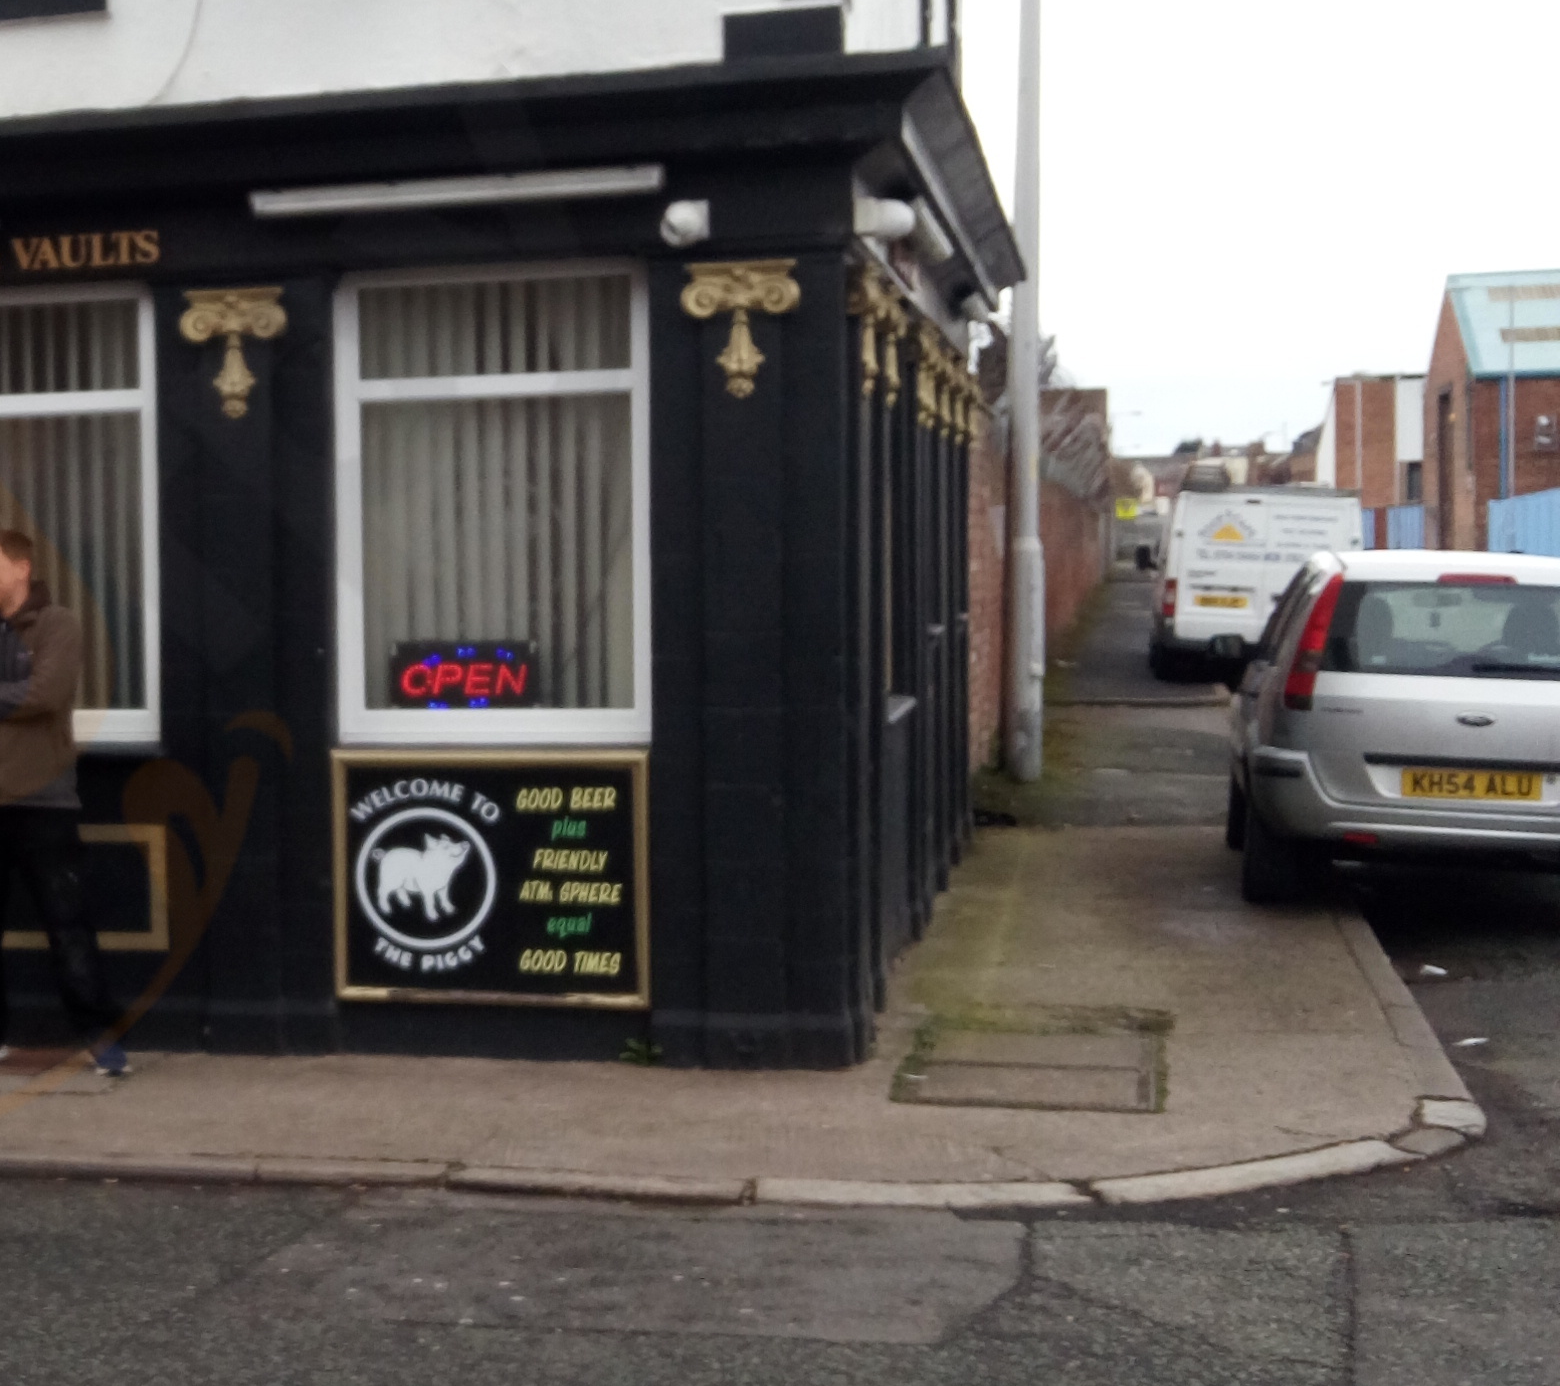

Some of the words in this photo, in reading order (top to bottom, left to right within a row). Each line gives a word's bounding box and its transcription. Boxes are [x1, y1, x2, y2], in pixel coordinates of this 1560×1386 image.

[11, 231, 160, 270] VAULTS
[400, 663, 527, 697] OPEN
[1411, 772, 1476, 794] KH54
[1485, 774, 1533, 796] ALU
[350, 778, 465, 821] WELCOME
[470, 792, 501, 822] TO
[516, 787, 563, 811] GOOD
[570, 787, 617, 811] BEER
[551, 816, 587, 840] plus
[533, 848, 608, 872] FRIENDLY
[546, 912, 592, 938] equal
[374, 937, 412, 969] THE
[421, 935, 485, 971] PIGGY
[519, 948, 567, 973] GOOD
[573, 951, 622, 976] TIMES
